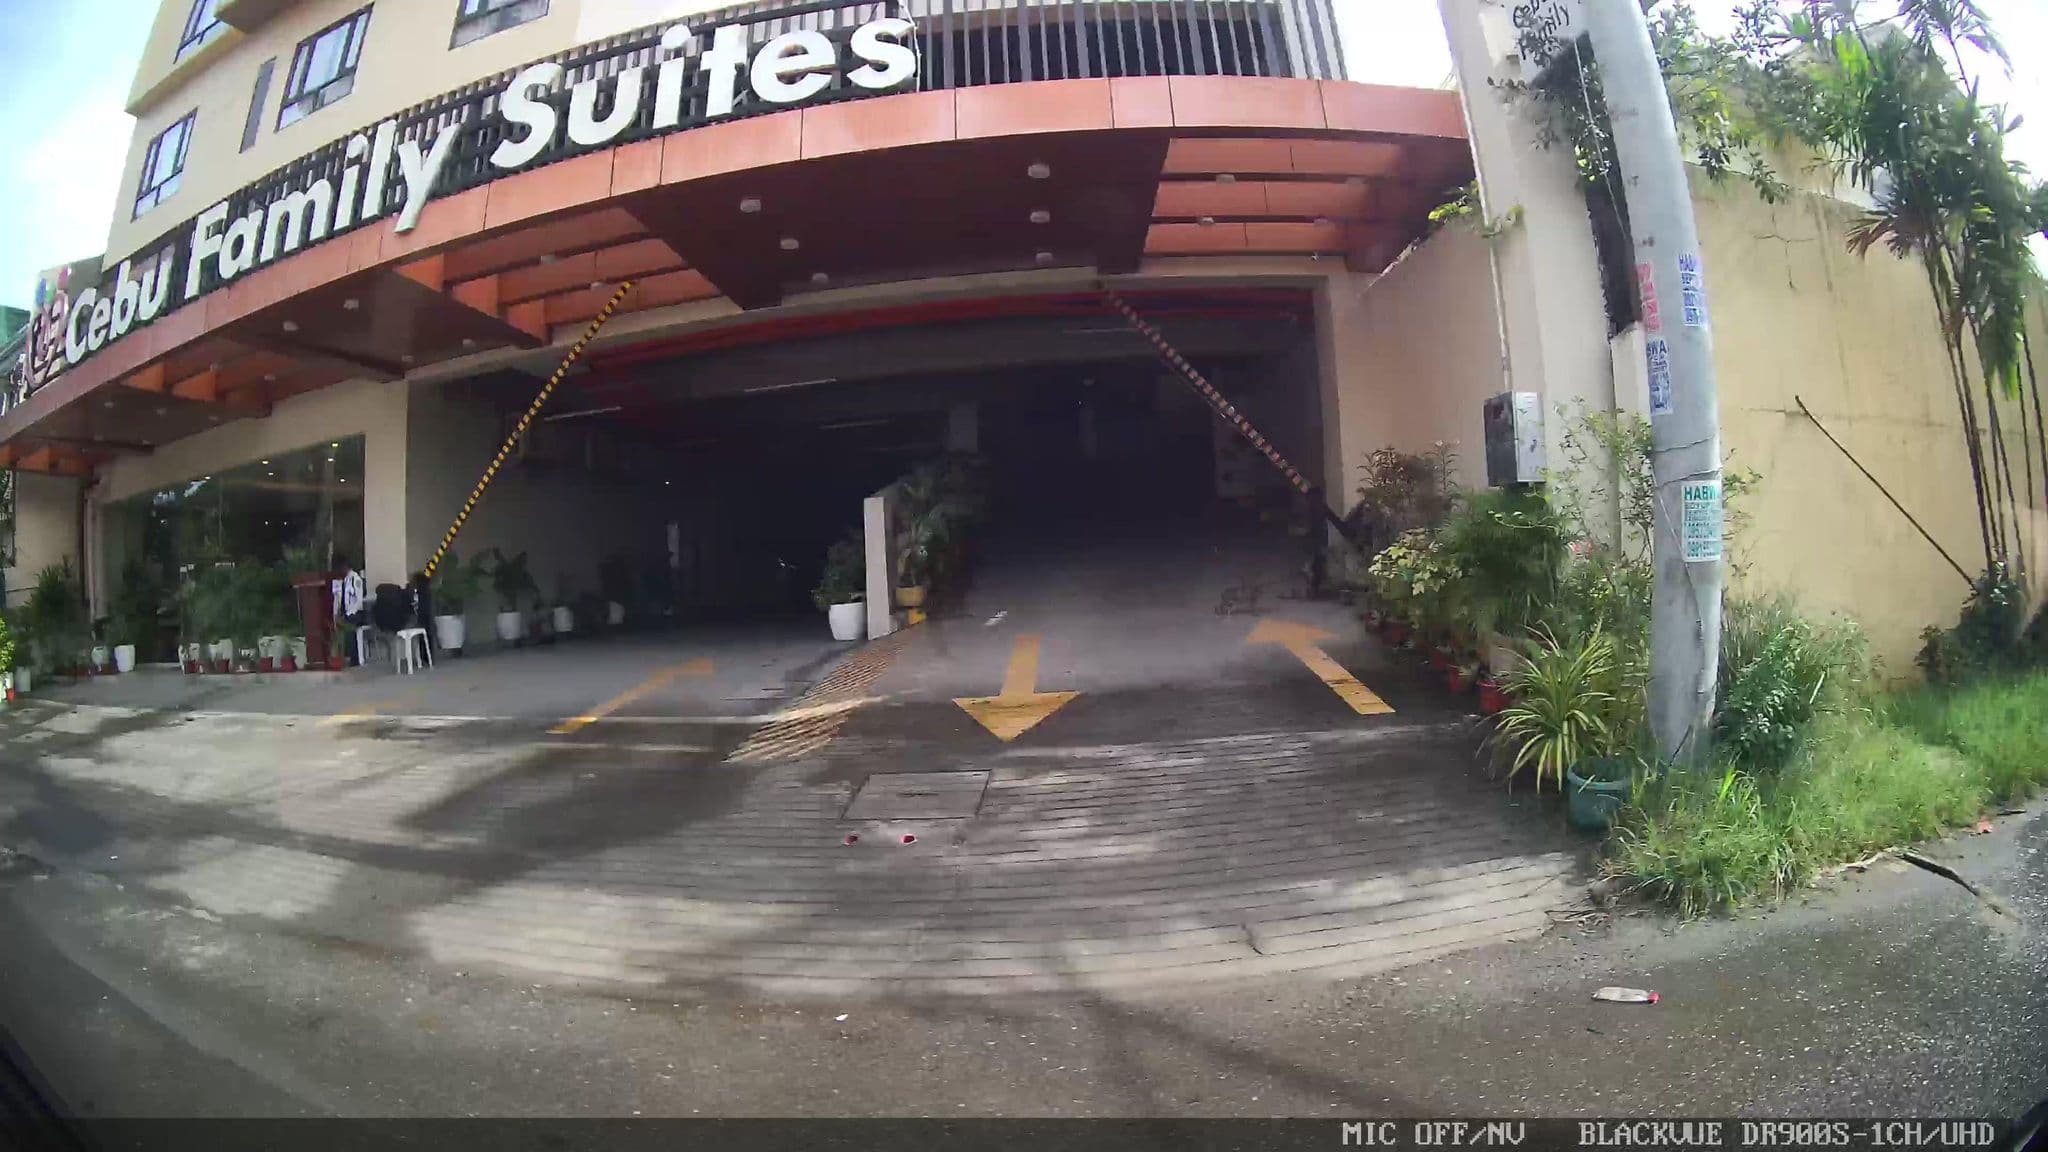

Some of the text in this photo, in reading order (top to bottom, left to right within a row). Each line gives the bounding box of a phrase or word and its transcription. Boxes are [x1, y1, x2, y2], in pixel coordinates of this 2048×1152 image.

[64, 18, 918, 363] Cebu Family Suites
